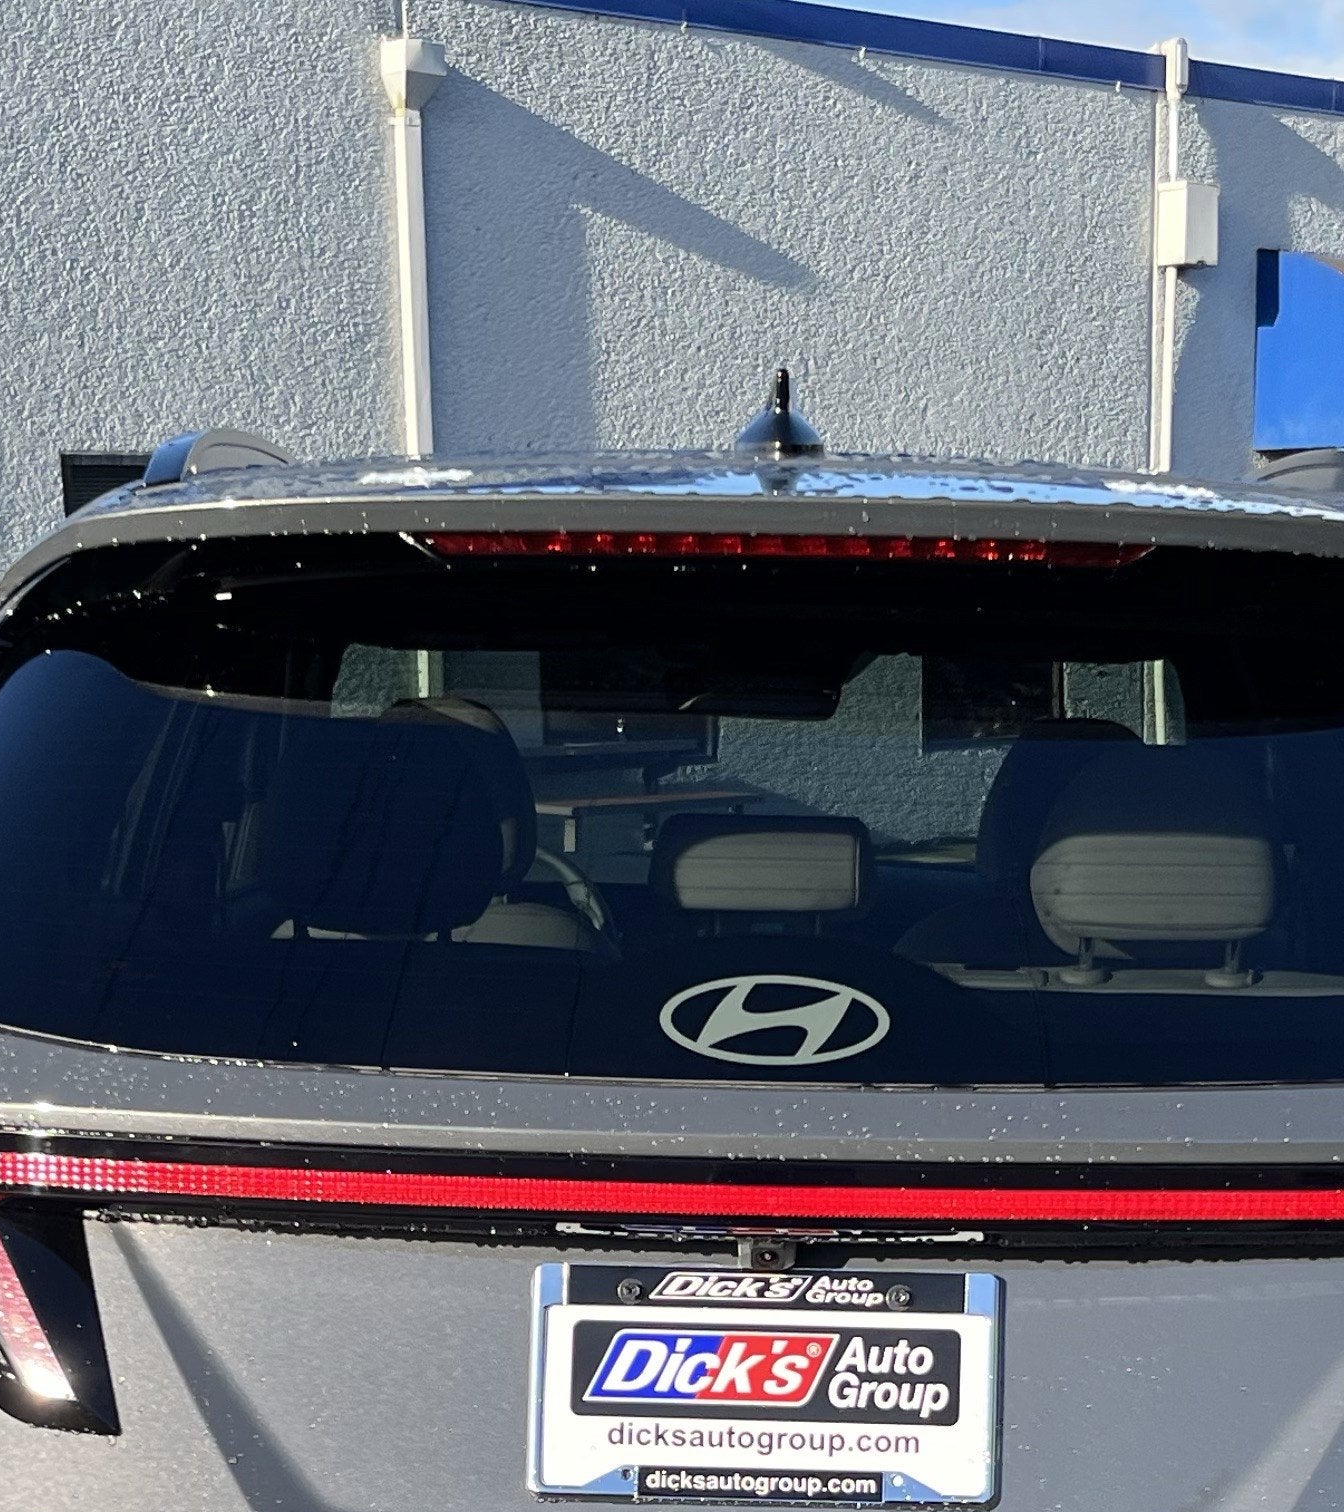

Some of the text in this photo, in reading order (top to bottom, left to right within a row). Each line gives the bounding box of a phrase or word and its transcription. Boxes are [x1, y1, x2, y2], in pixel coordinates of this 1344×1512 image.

[661, 1275, 796, 1298] Dick's
[805, 1289, 884, 1307] Group
[815, 1276, 874, 1292] Auto
[602, 1336, 809, 1395] Dick's
[835, 1336, 934, 1376] Auto
[828, 1373, 949, 1417] Group
[607, 1422, 921, 1456] dicksautogroup.com
[645, 1470, 877, 1497] dicksautogroup.com
